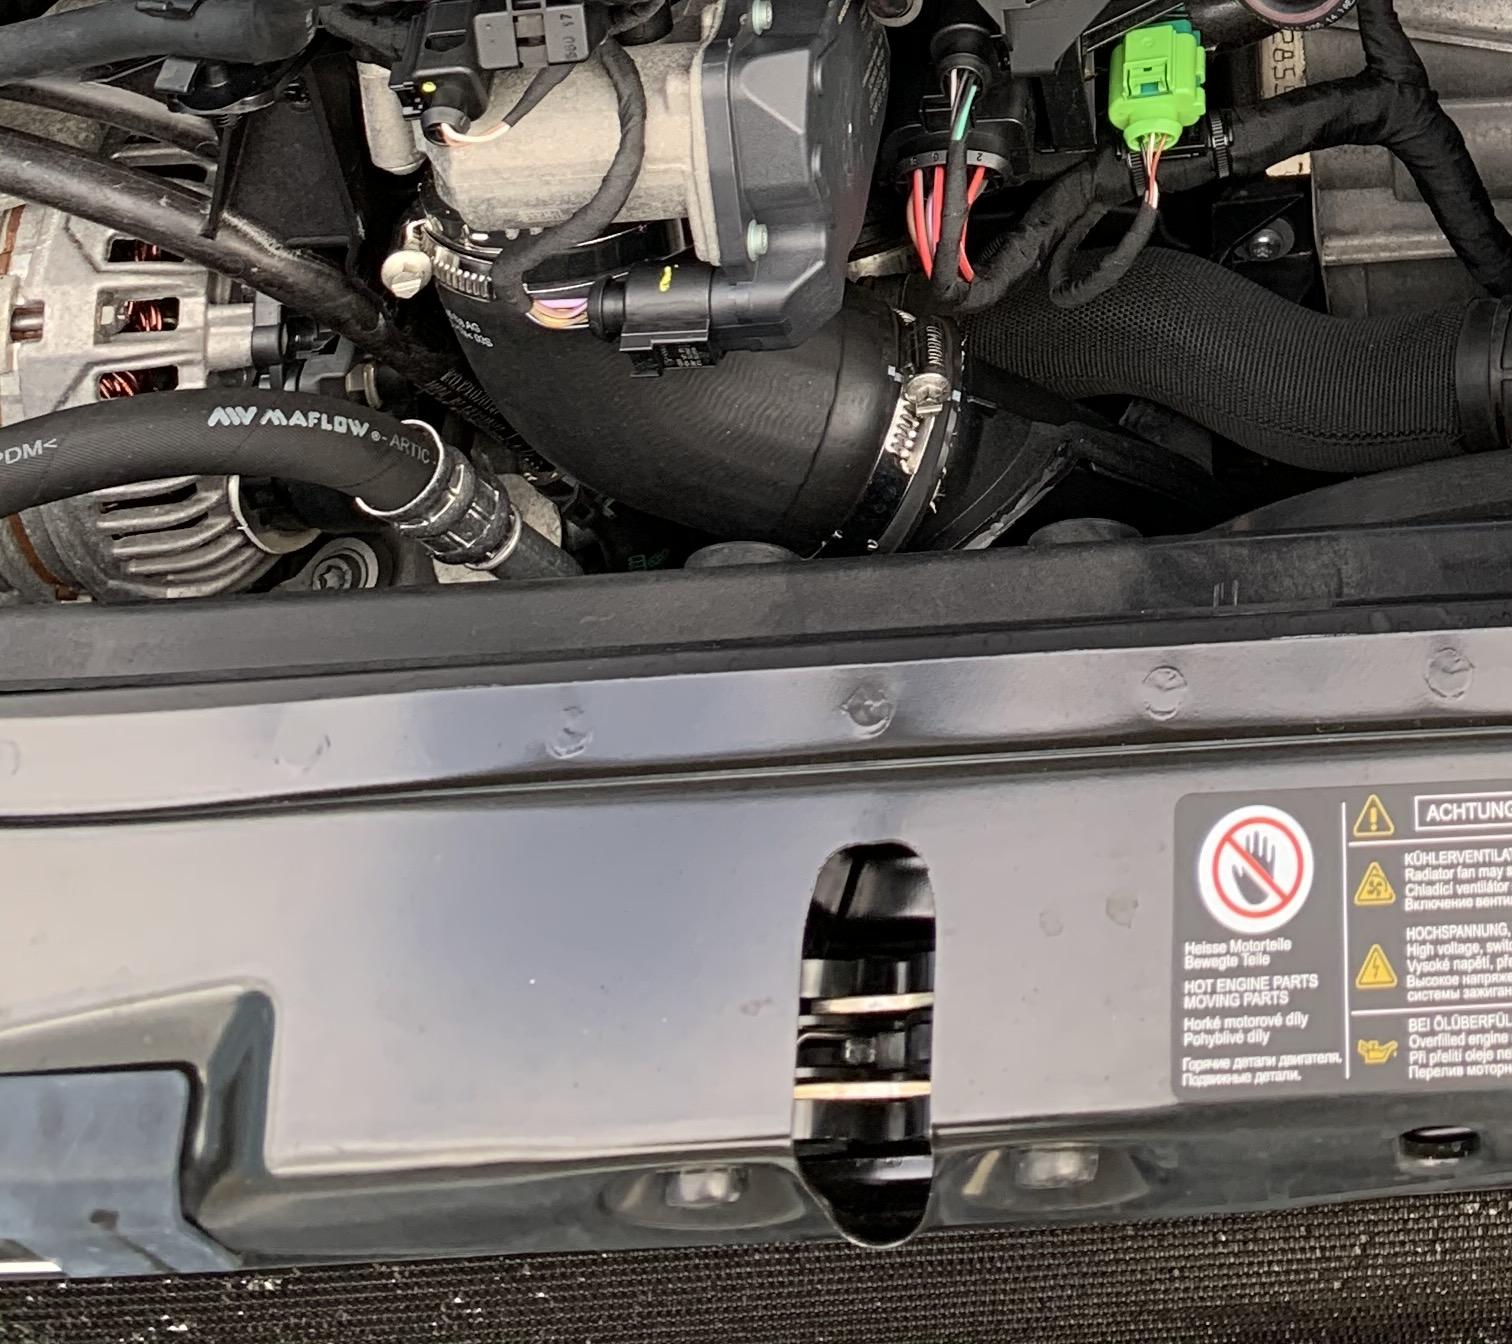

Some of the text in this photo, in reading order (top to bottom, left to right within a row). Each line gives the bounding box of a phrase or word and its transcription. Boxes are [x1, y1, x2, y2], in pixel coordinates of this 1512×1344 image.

[260, 408, 370, 438] MAFLOW
[1404, 867, 1454, 881] Radiator
[1456, 866, 1476, 879] fan
[1478, 867, 1504, 880] may
[1404, 897, 1473, 911] Включение
[1406, 923, 1511, 940] HOCHSPANNUNG,
[1184, 937, 1292, 955] Heisse Motorteile
[1406, 943, 1434, 958] High
[1437, 940, 1483, 956] voltage,
[1184, 952, 1271, 971] Bewegte Teile
[1406, 958, 1450, 974] Vysoké
[1452, 956, 1493, 971] napětí,
[1184, 974, 1319, 994] HOT ENGINE PARTS
[1406, 973, 1459, 987] Высокое
[1183, 991, 1290, 1009] MOVING PARTS
[1406, 989, 1460, 1001] системы
[1183, 1011, 1309, 1031] Horké motorové díly
[1408, 1019, 1430, 1032] BEI
[1183, 1028, 1271, 1048] Pohyblivé díly
[1408, 1032, 1466, 1047] Overfilled
[1468, 1030, 1508, 1046] engine
[1408, 1064, 1463, 1080] Перелив
